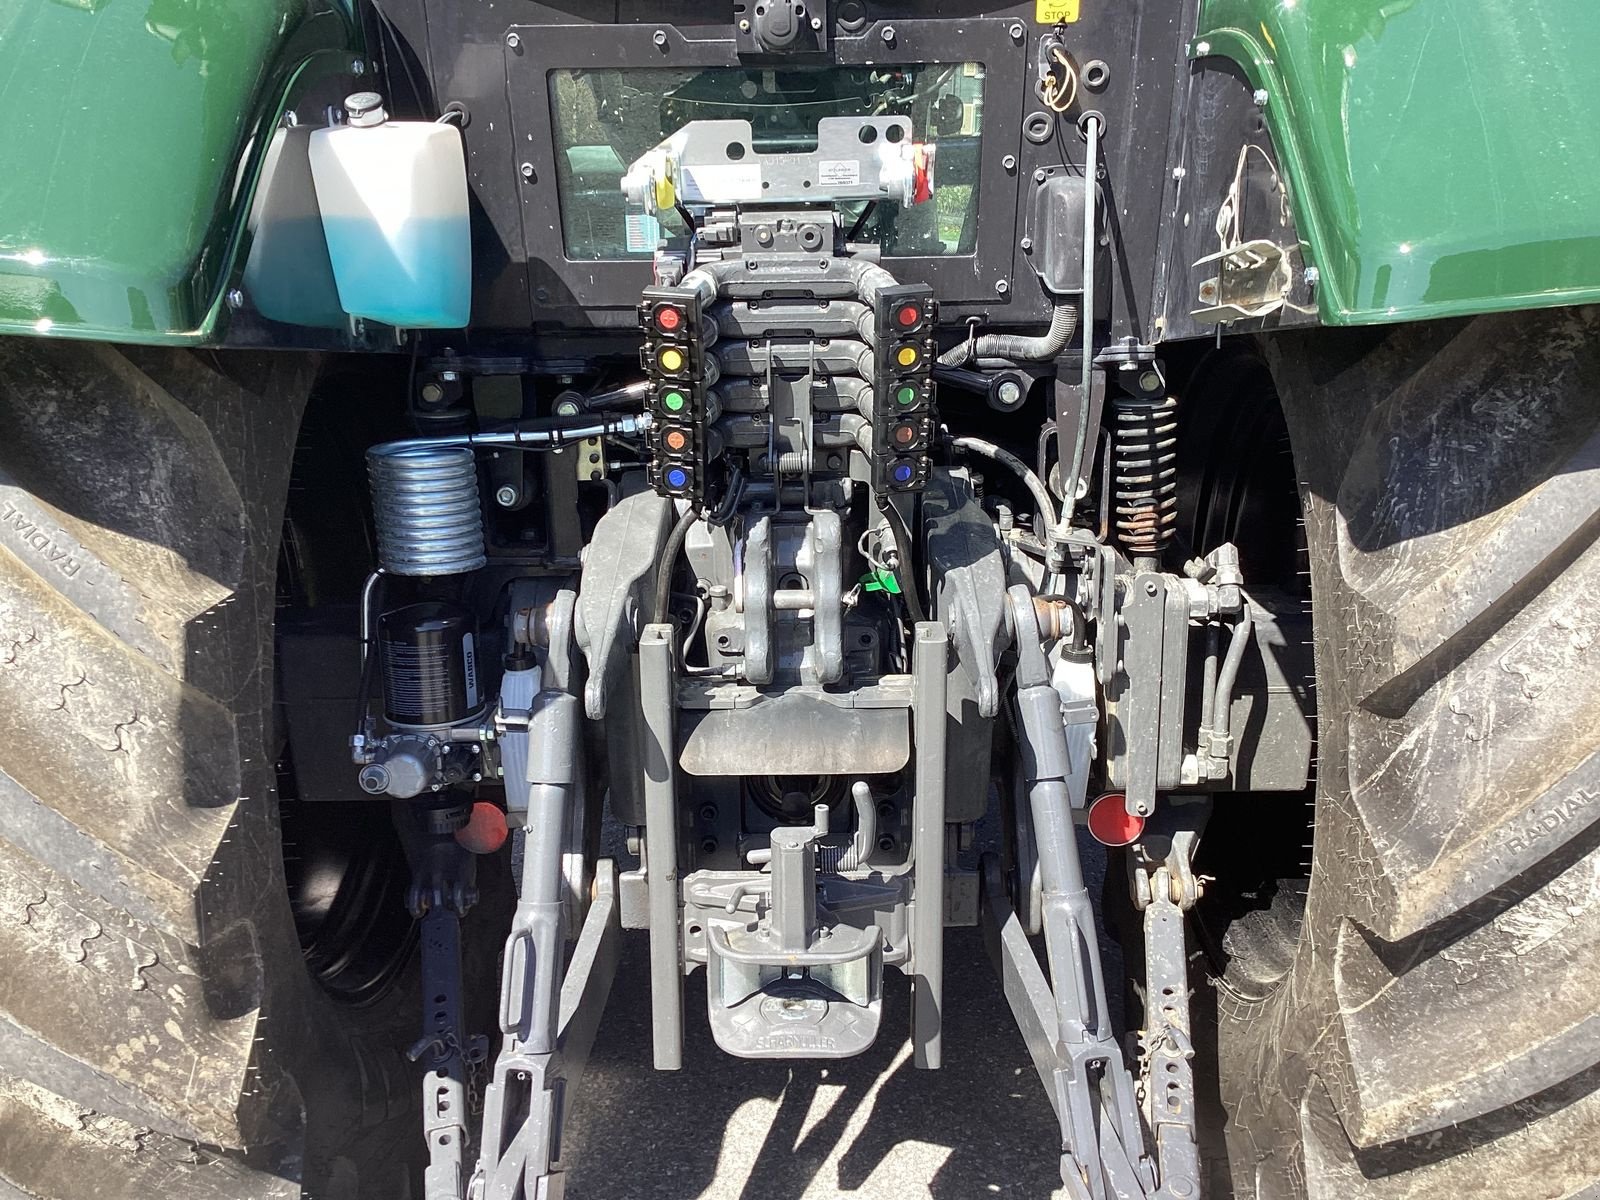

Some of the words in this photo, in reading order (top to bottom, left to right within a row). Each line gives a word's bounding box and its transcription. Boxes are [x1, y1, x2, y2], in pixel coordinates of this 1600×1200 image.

[1044, 11, 1071, 20] STOP
[3, 501, 81, 577] RADIAL
[465, 651, 475, 689] WABCO
[1503, 789, 1600, 856] RADIAL
